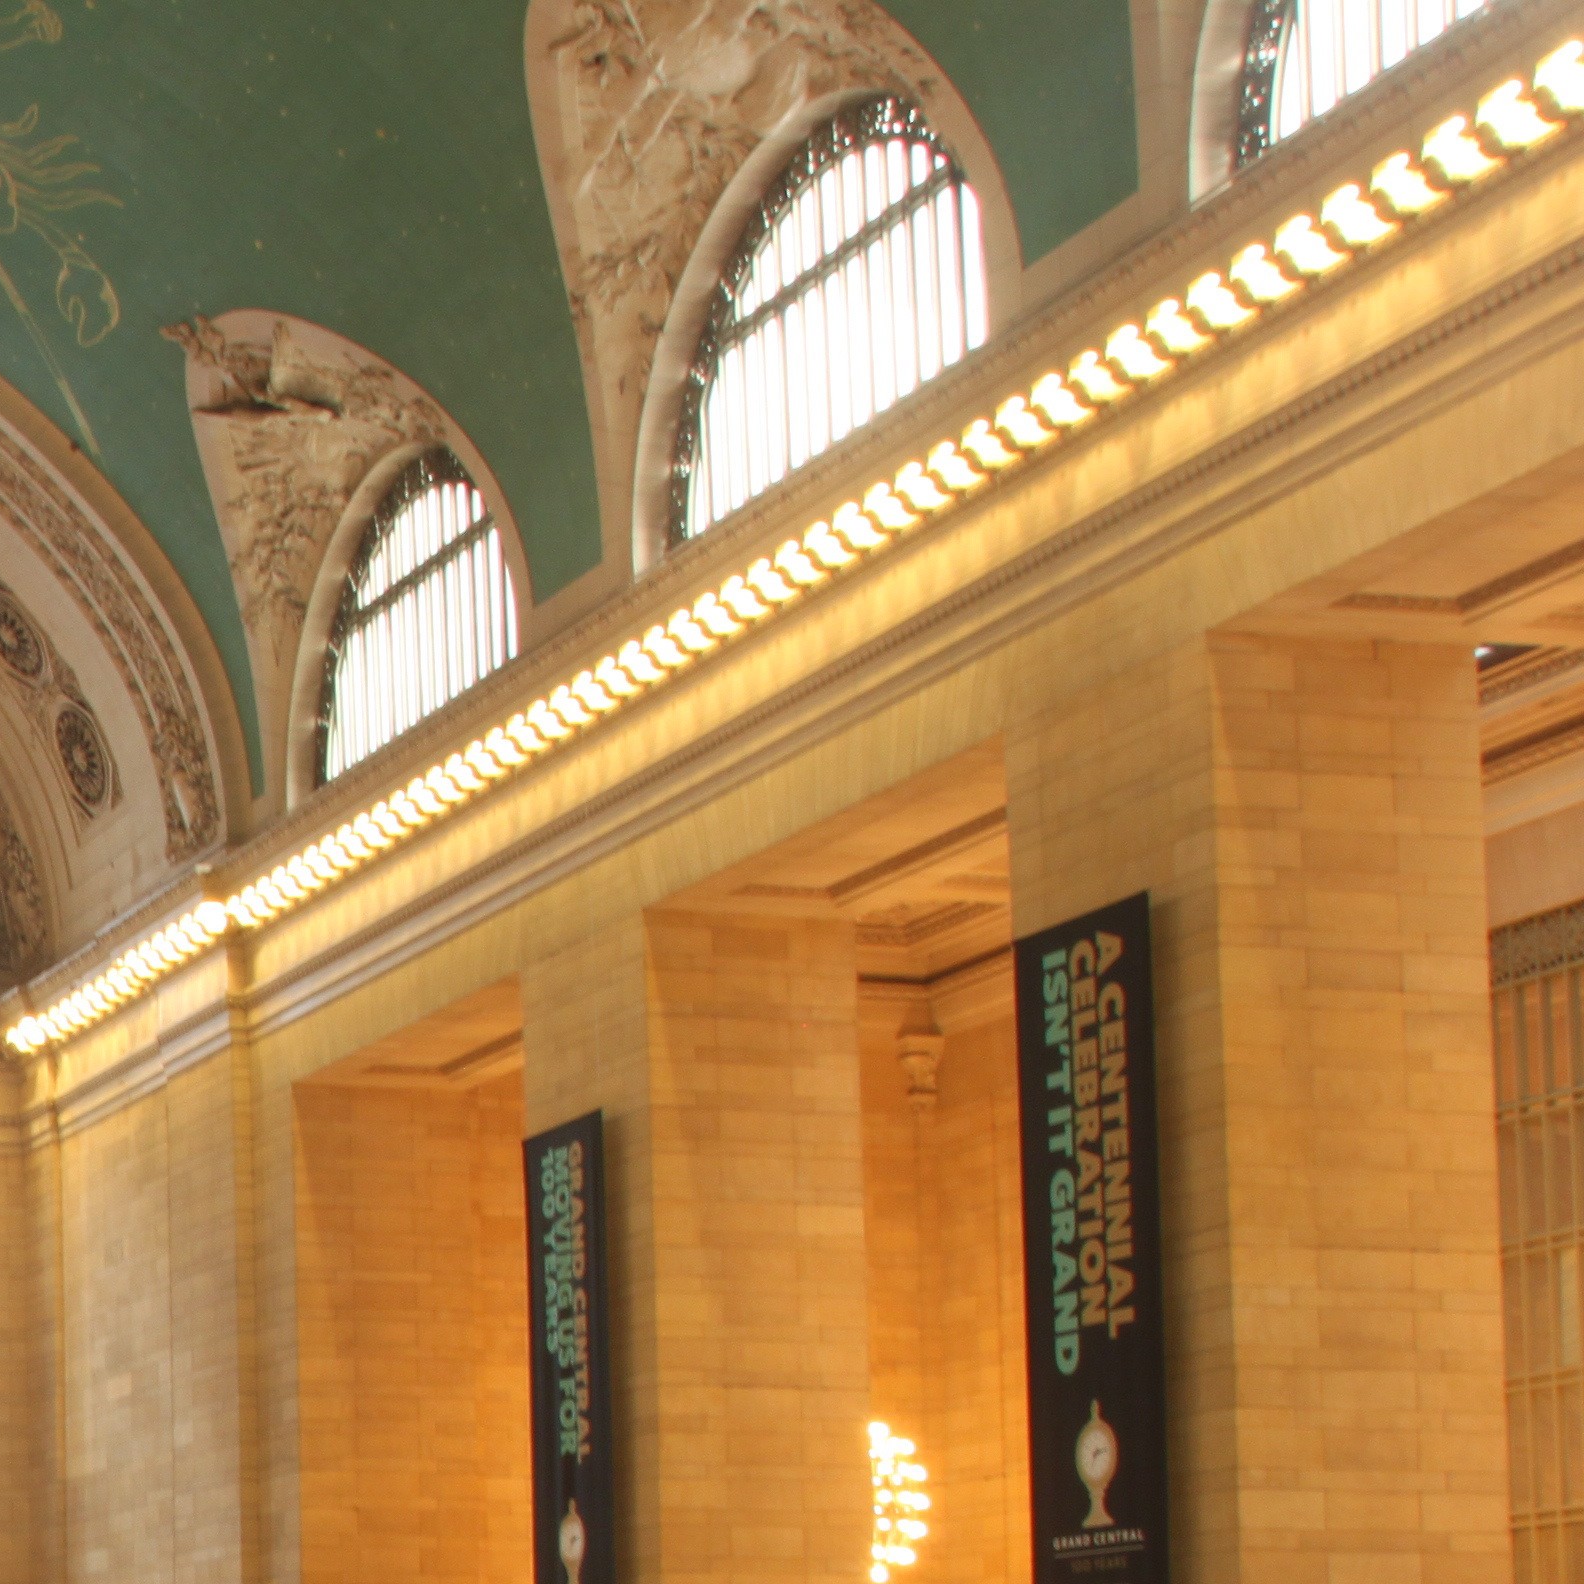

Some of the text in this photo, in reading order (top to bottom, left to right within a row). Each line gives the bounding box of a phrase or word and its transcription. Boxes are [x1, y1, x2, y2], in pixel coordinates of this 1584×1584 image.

[541, 1149, 560, 1355] 100 YEARS
[1042, 948, 1081, 1376] ISN'T IT GRAND
[1068, 938, 1109, 1329] CELEBRATION
[1094, 929, 1136, 1340] A CENTENNIAL
[553, 1145, 578, 1456] MOVING US FOR
[568, 1140, 592, 1466] GRAND CENTRAL
[1053, 1528, 1146, 1550] GRAND CENTRAL
